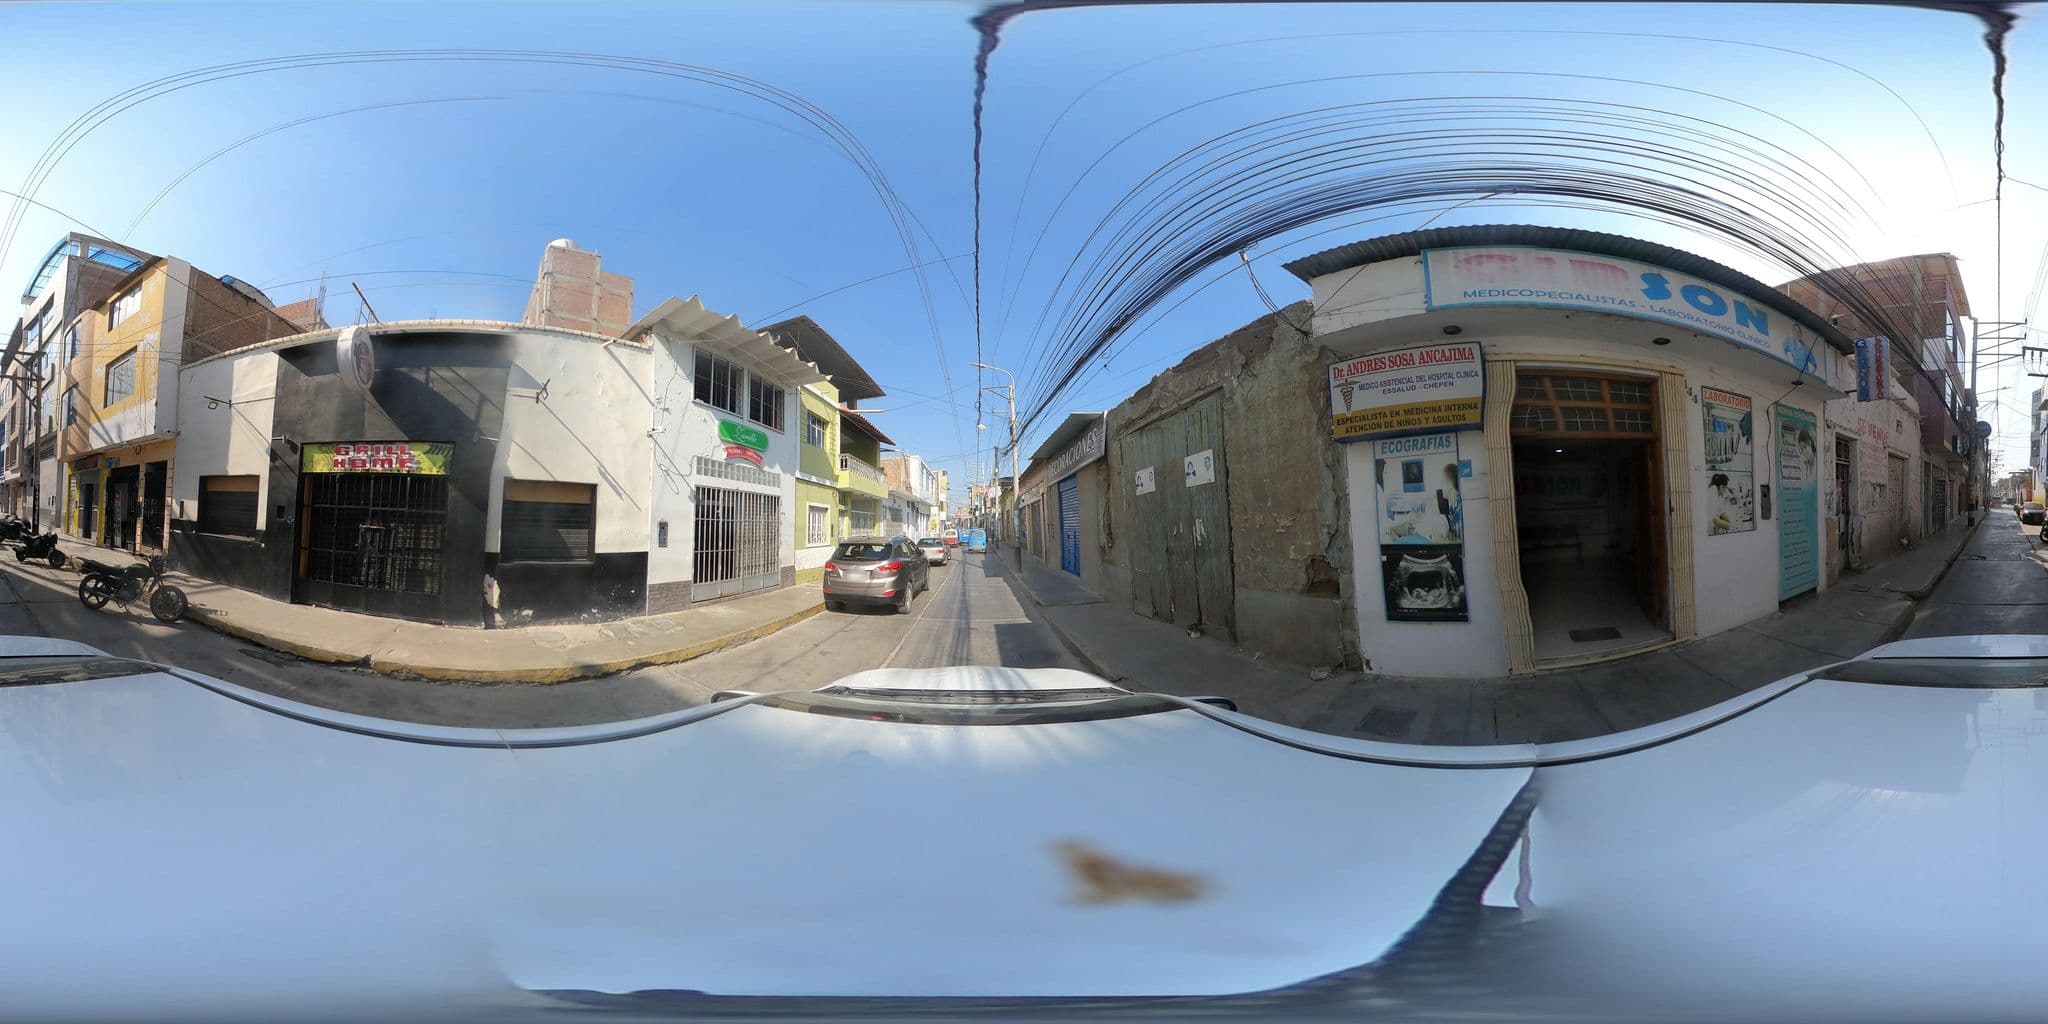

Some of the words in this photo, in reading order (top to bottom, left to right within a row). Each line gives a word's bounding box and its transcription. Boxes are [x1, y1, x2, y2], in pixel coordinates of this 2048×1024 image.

[1332, 366, 1345, 379] Dr.
[1347, 356, 1387, 376] ANDRES
[1387, 352, 1416, 368] SOSA
[1419, 346, 1475, 365] ANCAJIMA
[1358, 381, 1379, 392] MEDICO
[1415, 374, 1426, 383] DEL
[1427, 371, 1455, 381] HOSPITAL
[1382, 385, 1417, 396] ESSALUD
[1423, 381, 1454, 391] CHEPEN
[1703, 389, 1751, 411] LABORATORIO
[1336, 411, 1388, 425] ESPECIALISTA
[1390, 409, 1401, 418] EN
[1403, 405, 1443, 416] MEDICINA
[1444, 402, 1479, 412] INTERNA
[1344, 422, 1382, 434] ATENCION
[1384, 420, 1395, 429] DE
[1396, 416, 1422, 428] NIÑOS
[1425, 416, 1430, 424] Y
[1432, 414, 1466, 424] ADULTOS
[333, 443, 411, 457] GRILL
[1380, 436, 1451, 454] ECOGRAFIAS
[331, 456, 417, 470] HOME
